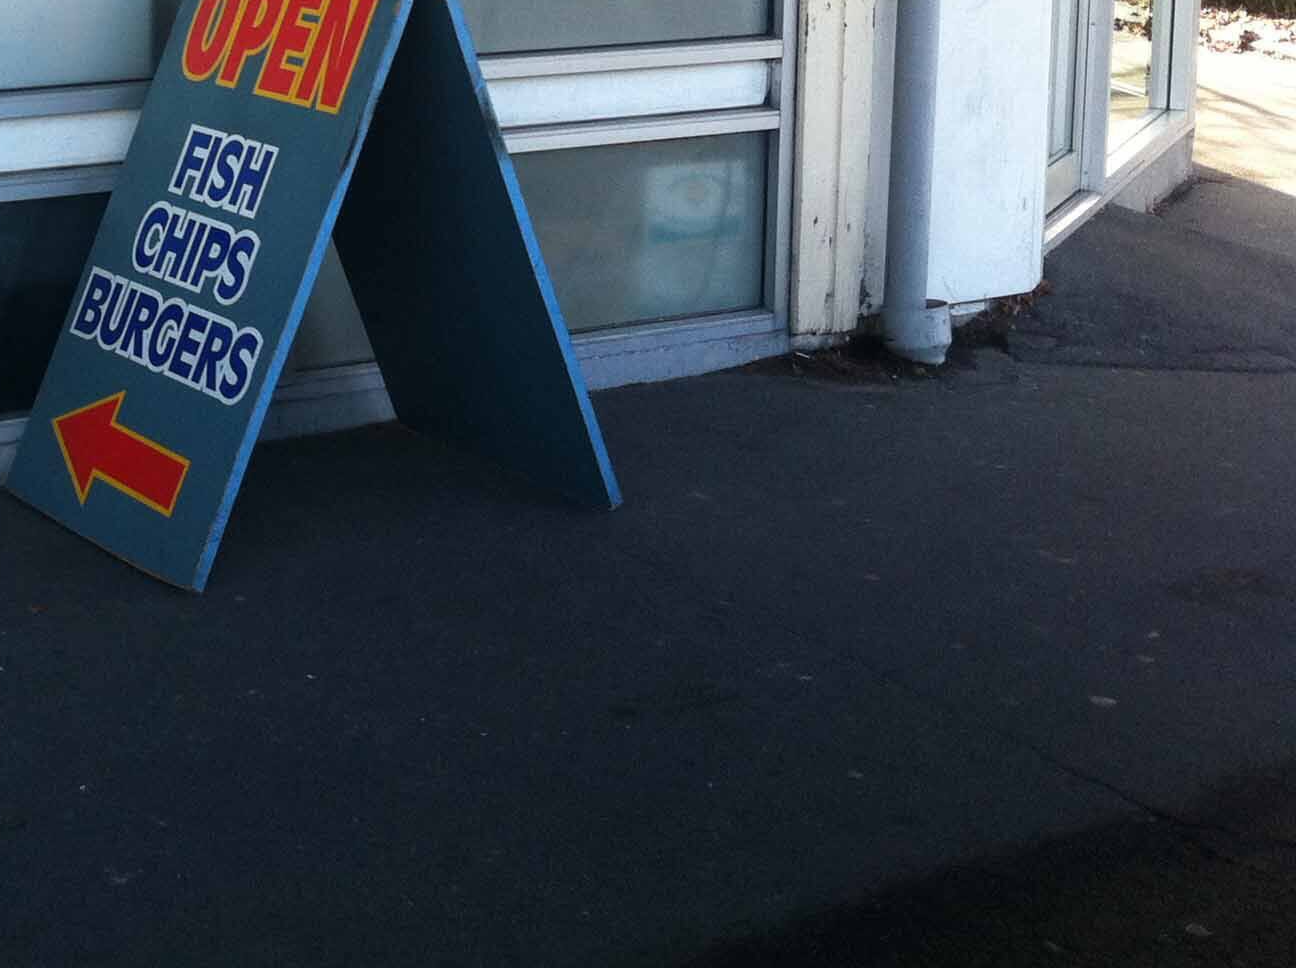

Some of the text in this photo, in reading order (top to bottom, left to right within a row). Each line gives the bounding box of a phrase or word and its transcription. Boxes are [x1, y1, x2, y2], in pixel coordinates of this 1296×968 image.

[168, 123, 279, 220] FISH
[132, 201, 261, 306] CHIPS
[70, 266, 264, 406] BURGERS
